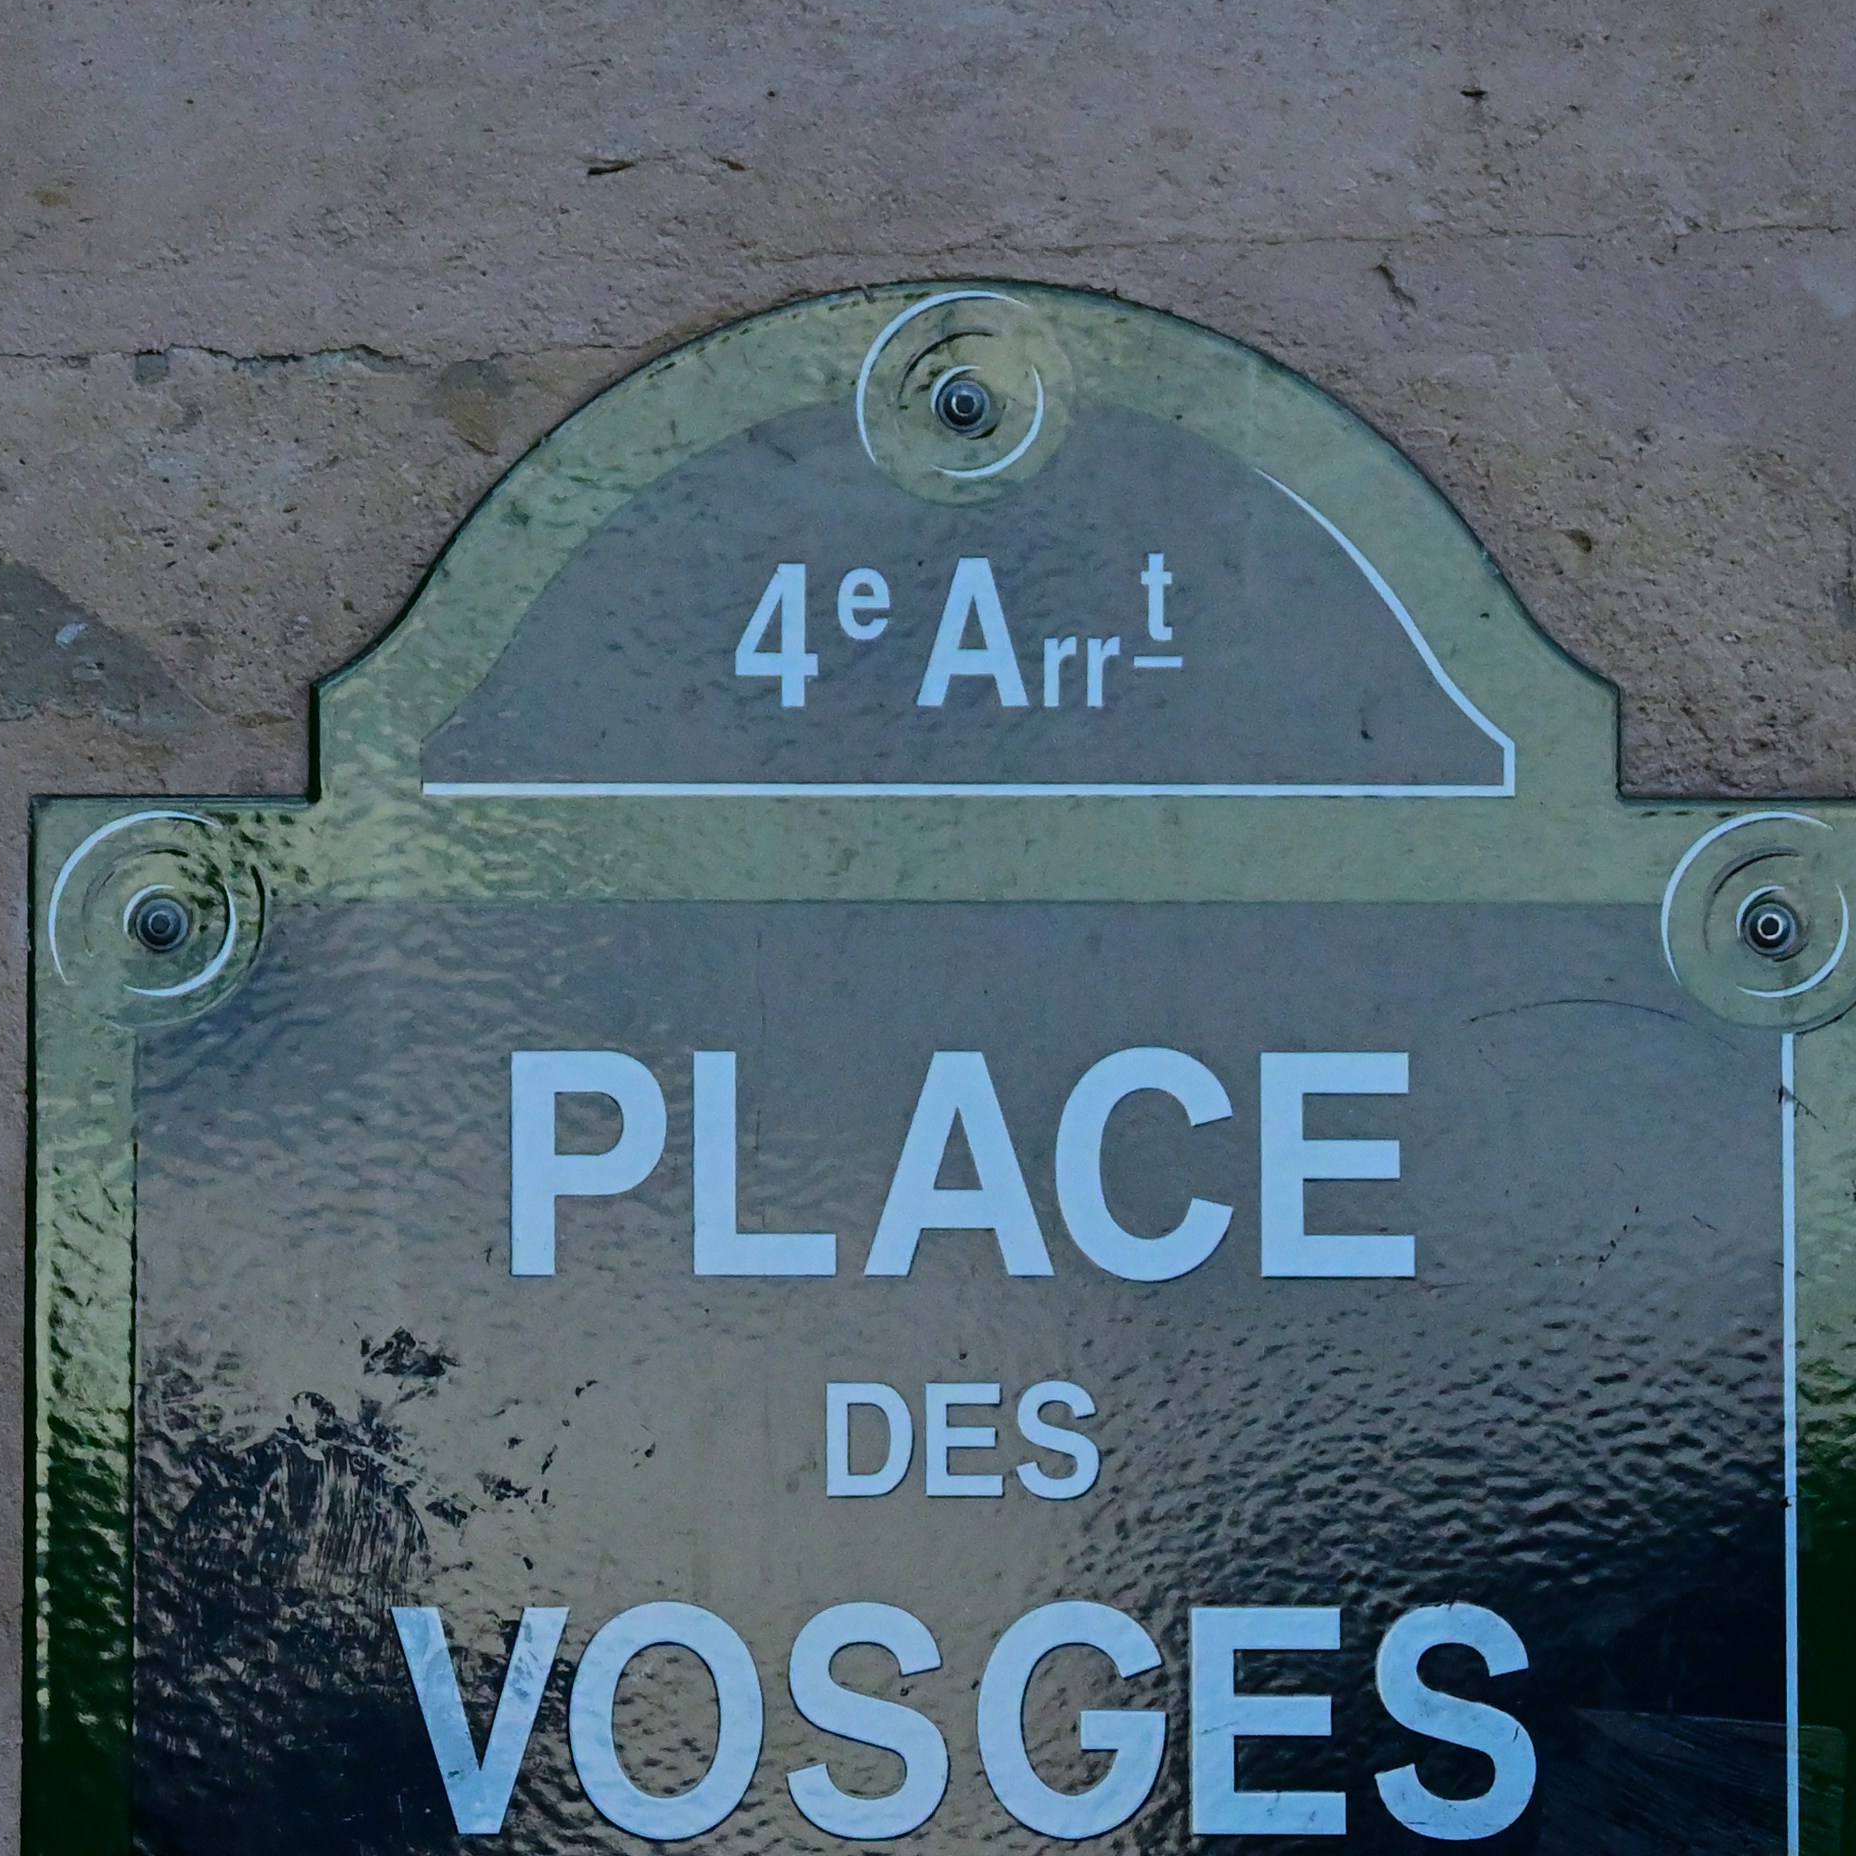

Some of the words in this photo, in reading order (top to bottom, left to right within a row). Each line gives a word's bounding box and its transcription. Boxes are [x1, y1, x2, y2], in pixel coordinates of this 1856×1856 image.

[510, 1046, 1418, 1282] PLACE
[825, 1380, 1101, 1500] DES
[392, 1599, 1540, 1839] VOSGES
